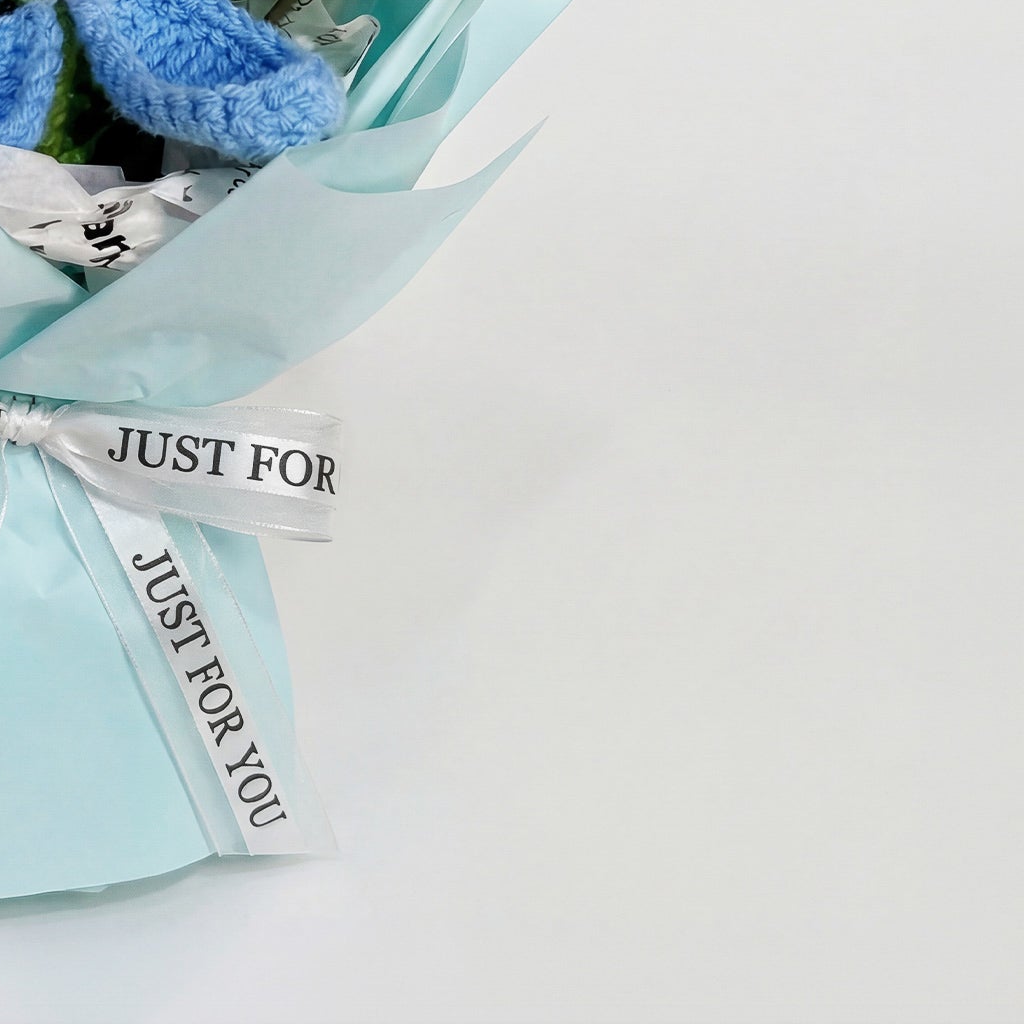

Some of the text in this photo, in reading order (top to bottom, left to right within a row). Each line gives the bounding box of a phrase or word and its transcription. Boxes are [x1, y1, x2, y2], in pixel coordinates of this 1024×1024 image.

[107, 426, 336, 495] JUST FOR
[132, 548, 288, 828] JUST FOR YOU
